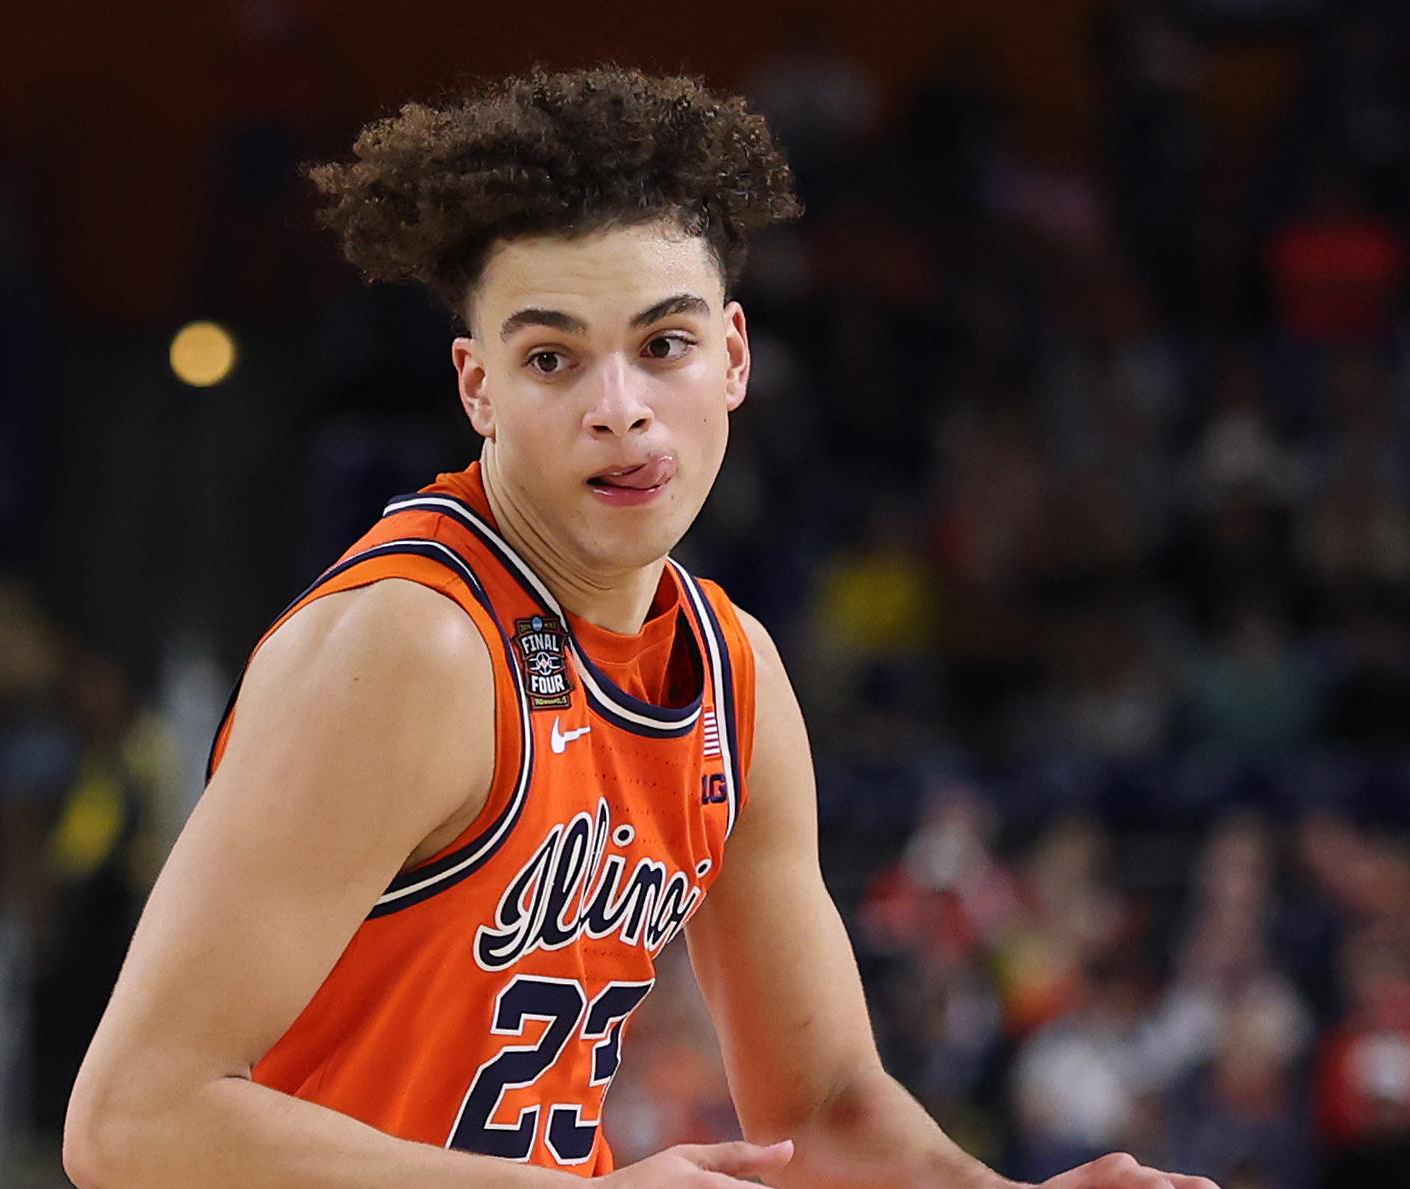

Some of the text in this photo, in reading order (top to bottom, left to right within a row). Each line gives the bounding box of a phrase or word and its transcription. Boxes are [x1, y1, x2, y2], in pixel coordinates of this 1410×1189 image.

[521, 633, 559, 654] FINAL
[531, 674, 565, 694] FOUR
[473, 796, 712, 972] Illinoi
[448, 973, 656, 1166] 23
